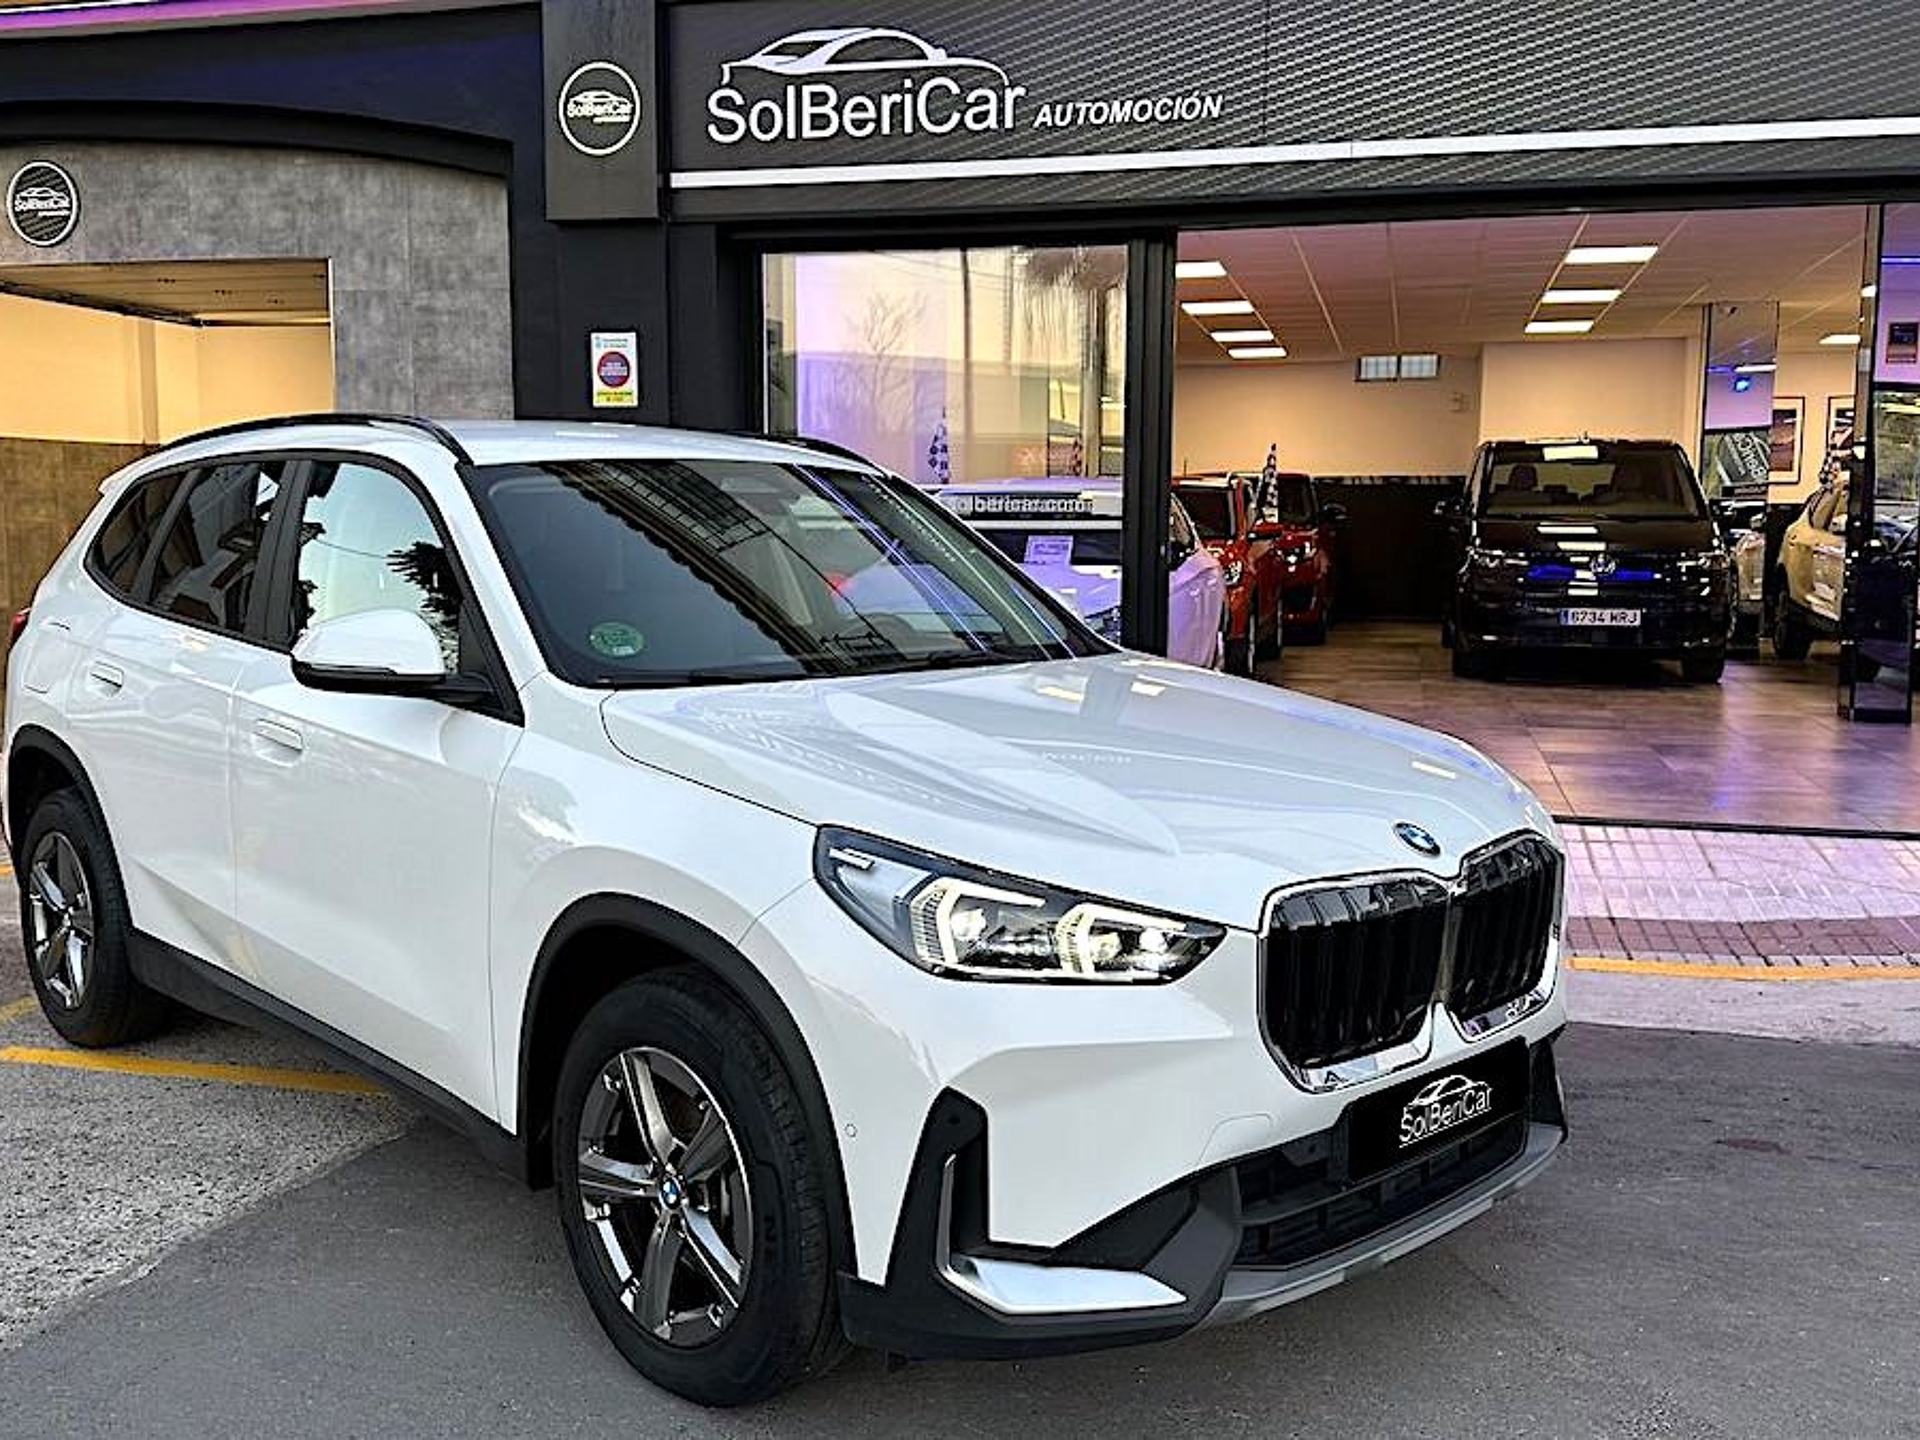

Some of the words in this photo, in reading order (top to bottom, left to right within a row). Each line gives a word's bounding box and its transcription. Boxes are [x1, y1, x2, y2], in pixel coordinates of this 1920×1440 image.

[706, 76, 1027, 144] SolBeriCar
[1033, 93, 1224, 129] AUTOMOCIÓN
[1399, 1086, 1493, 1143] SolBeriCar
